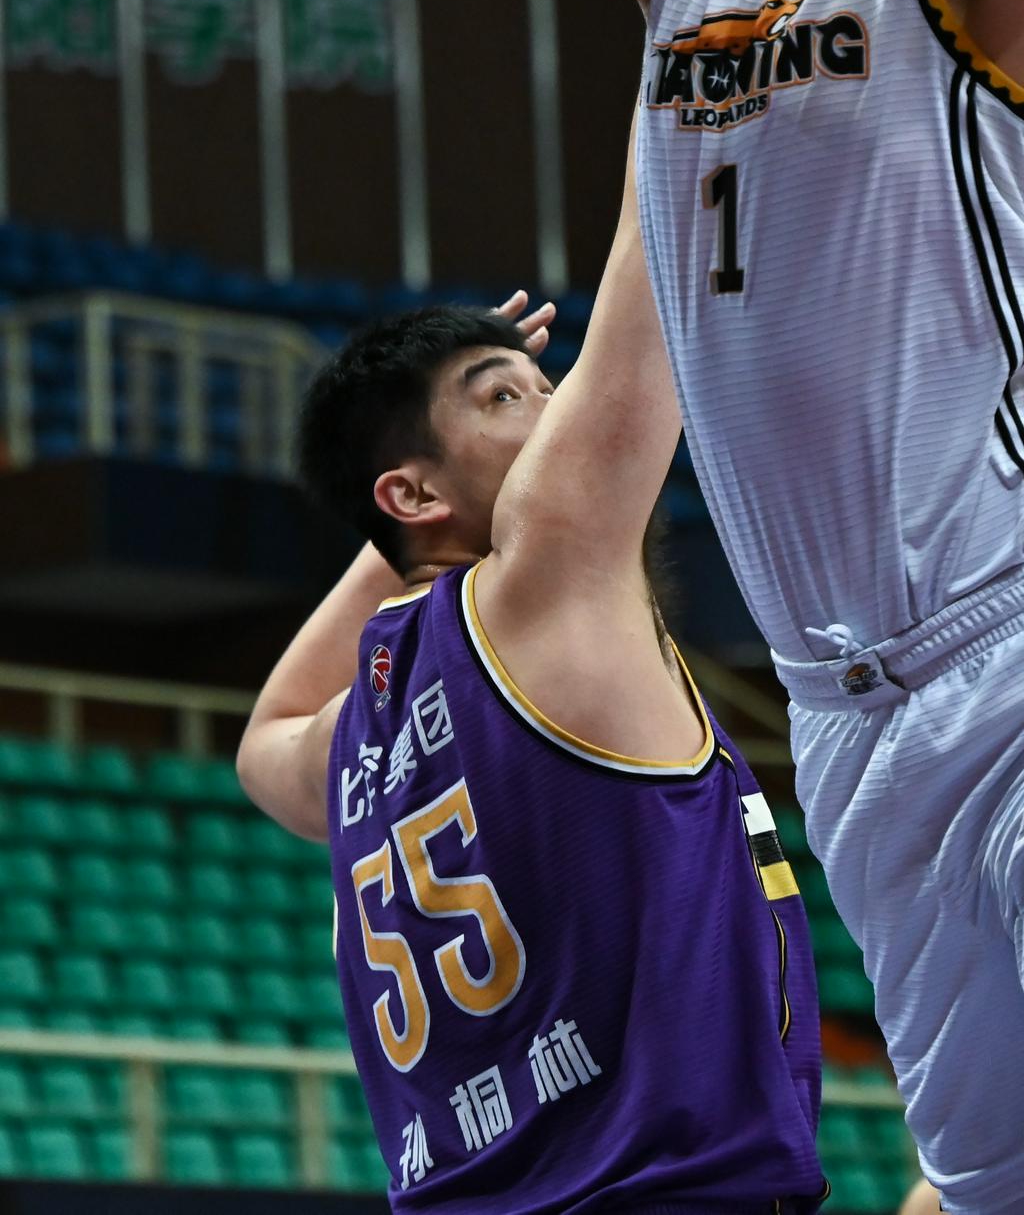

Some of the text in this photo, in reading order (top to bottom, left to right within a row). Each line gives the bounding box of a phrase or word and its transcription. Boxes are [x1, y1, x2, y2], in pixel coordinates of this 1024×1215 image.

[680, 93, 768, 128] LEOPARDS
[702, 163, 744, 297] 1
[351, 776, 527, 1073] 55
